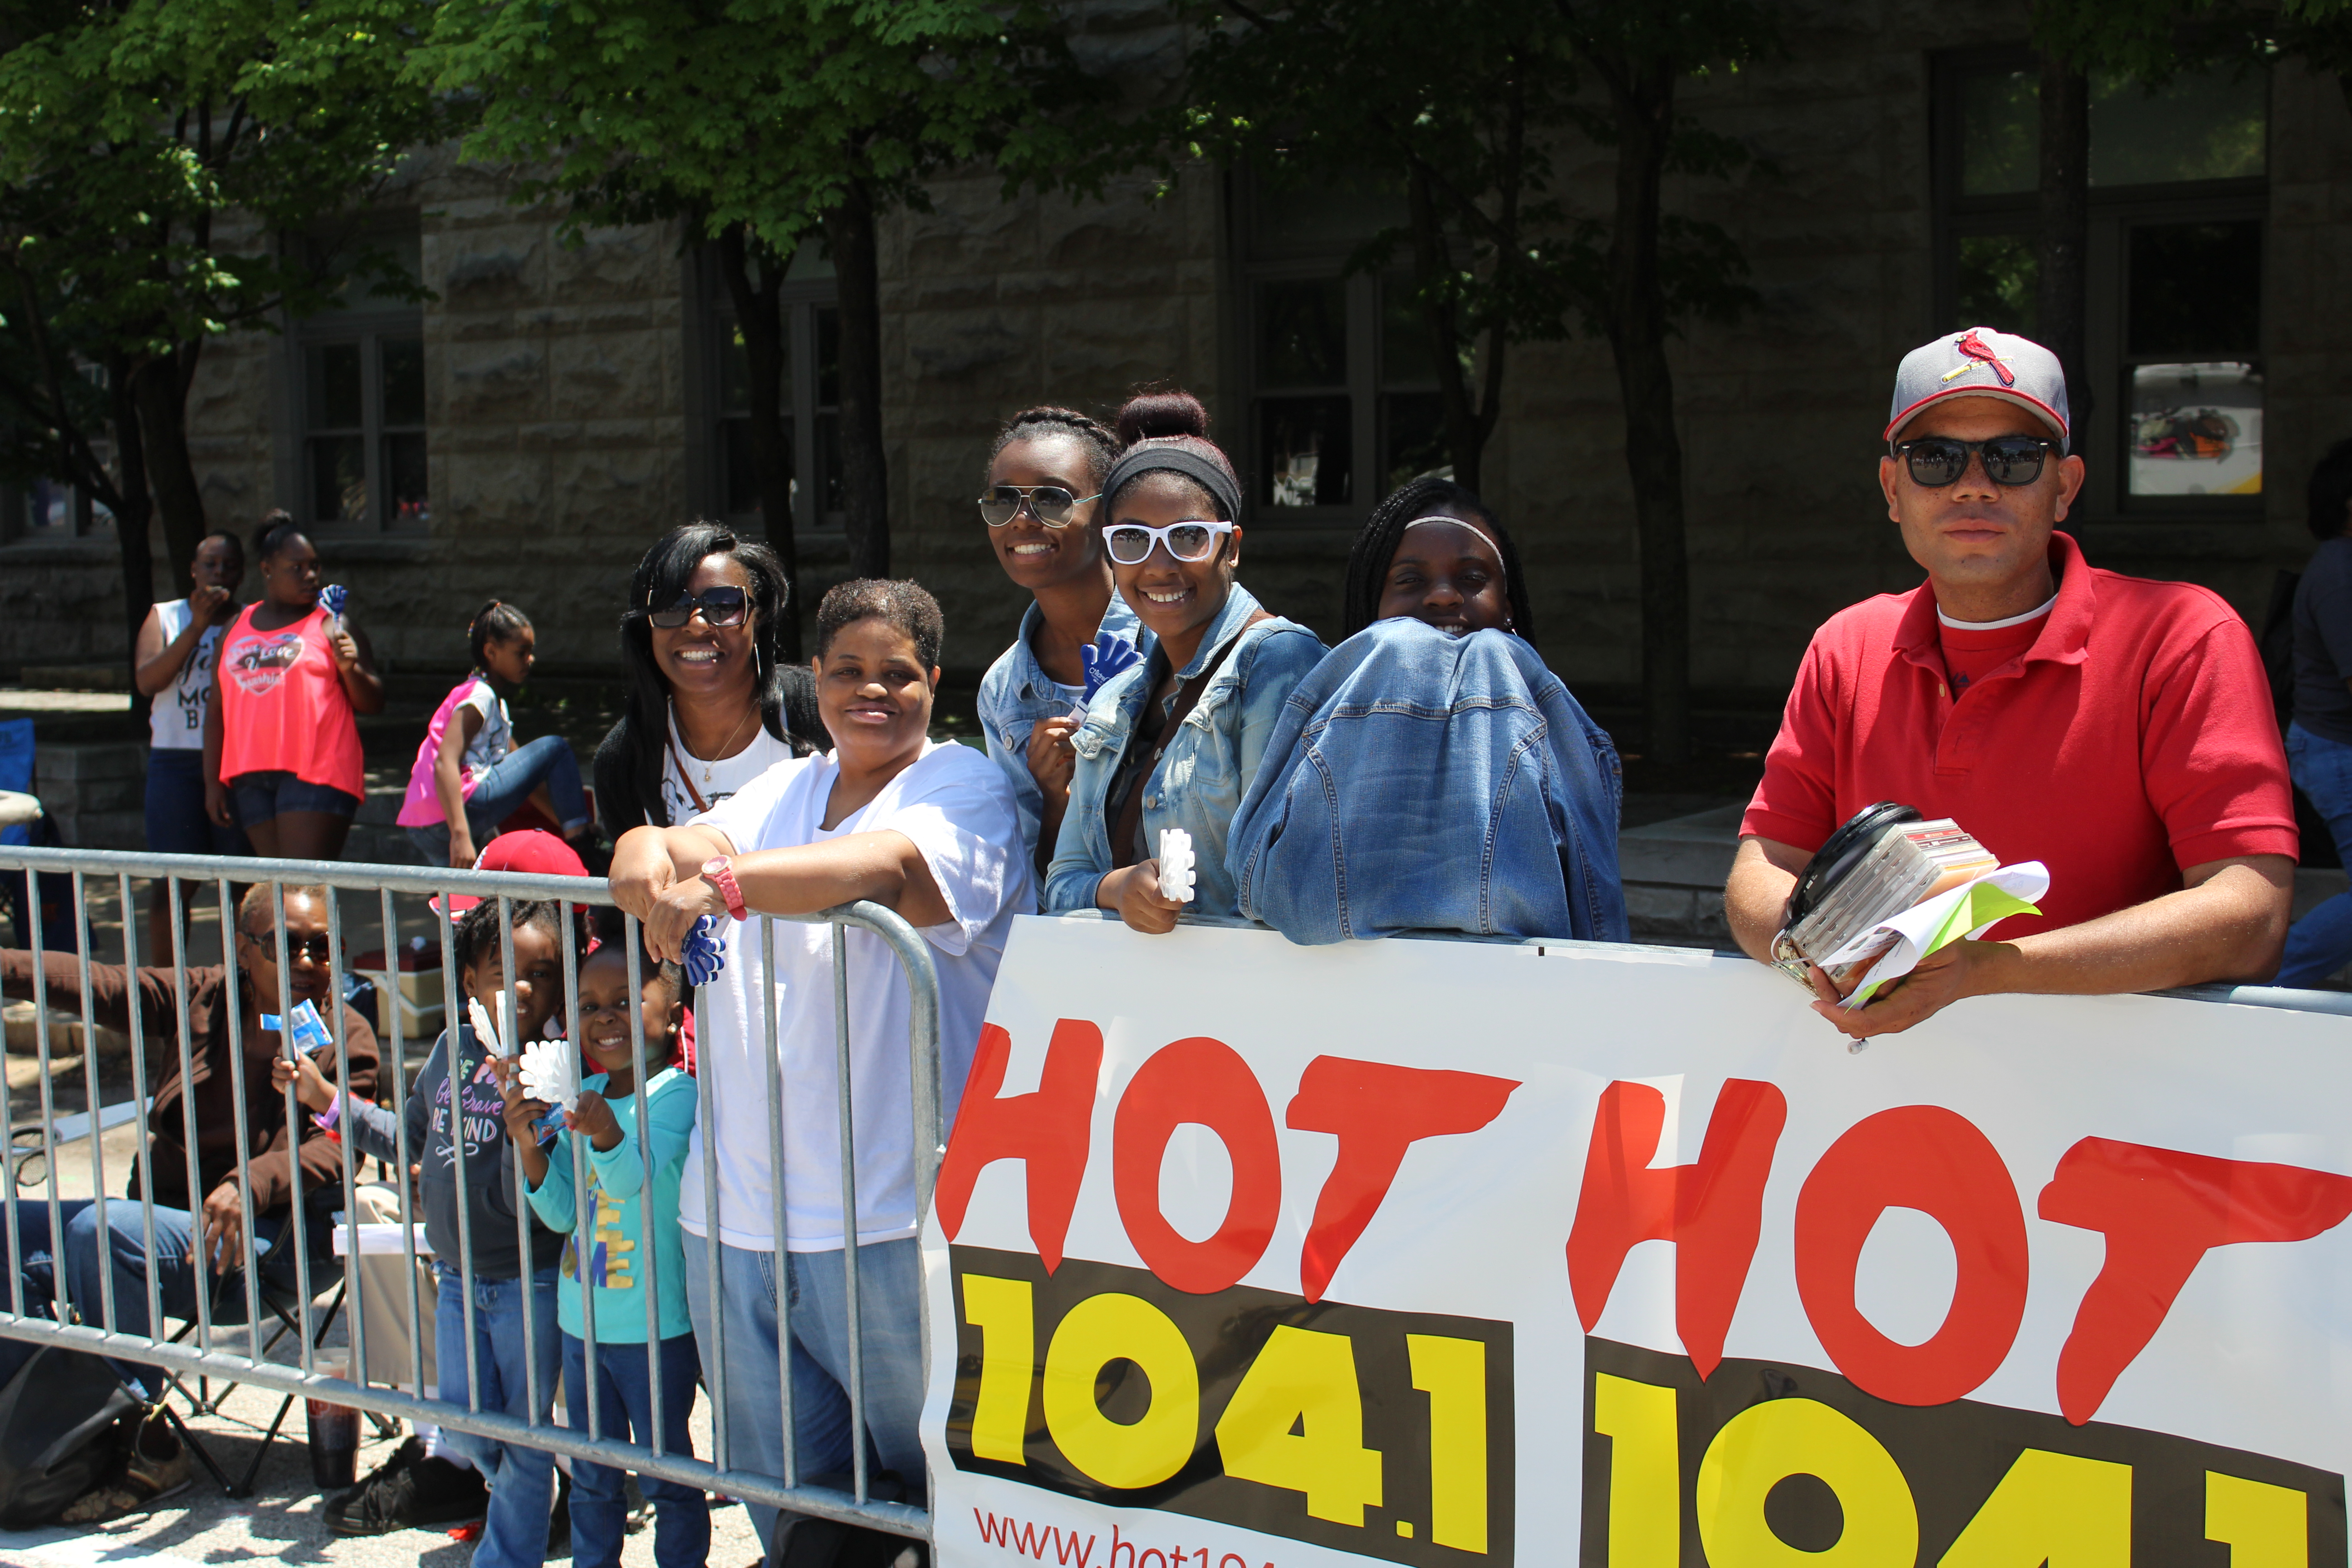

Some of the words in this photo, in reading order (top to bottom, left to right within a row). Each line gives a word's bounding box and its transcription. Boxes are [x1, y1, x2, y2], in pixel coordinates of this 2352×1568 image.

[432, 1107, 448, 1133] BE
[450, 1116, 497, 1142] IND
[935, 1018, 1524, 1304] HOT
[1566, 1078, 2352, 1426] HOT
[961, 1273, 1488, 1555] 104.1
